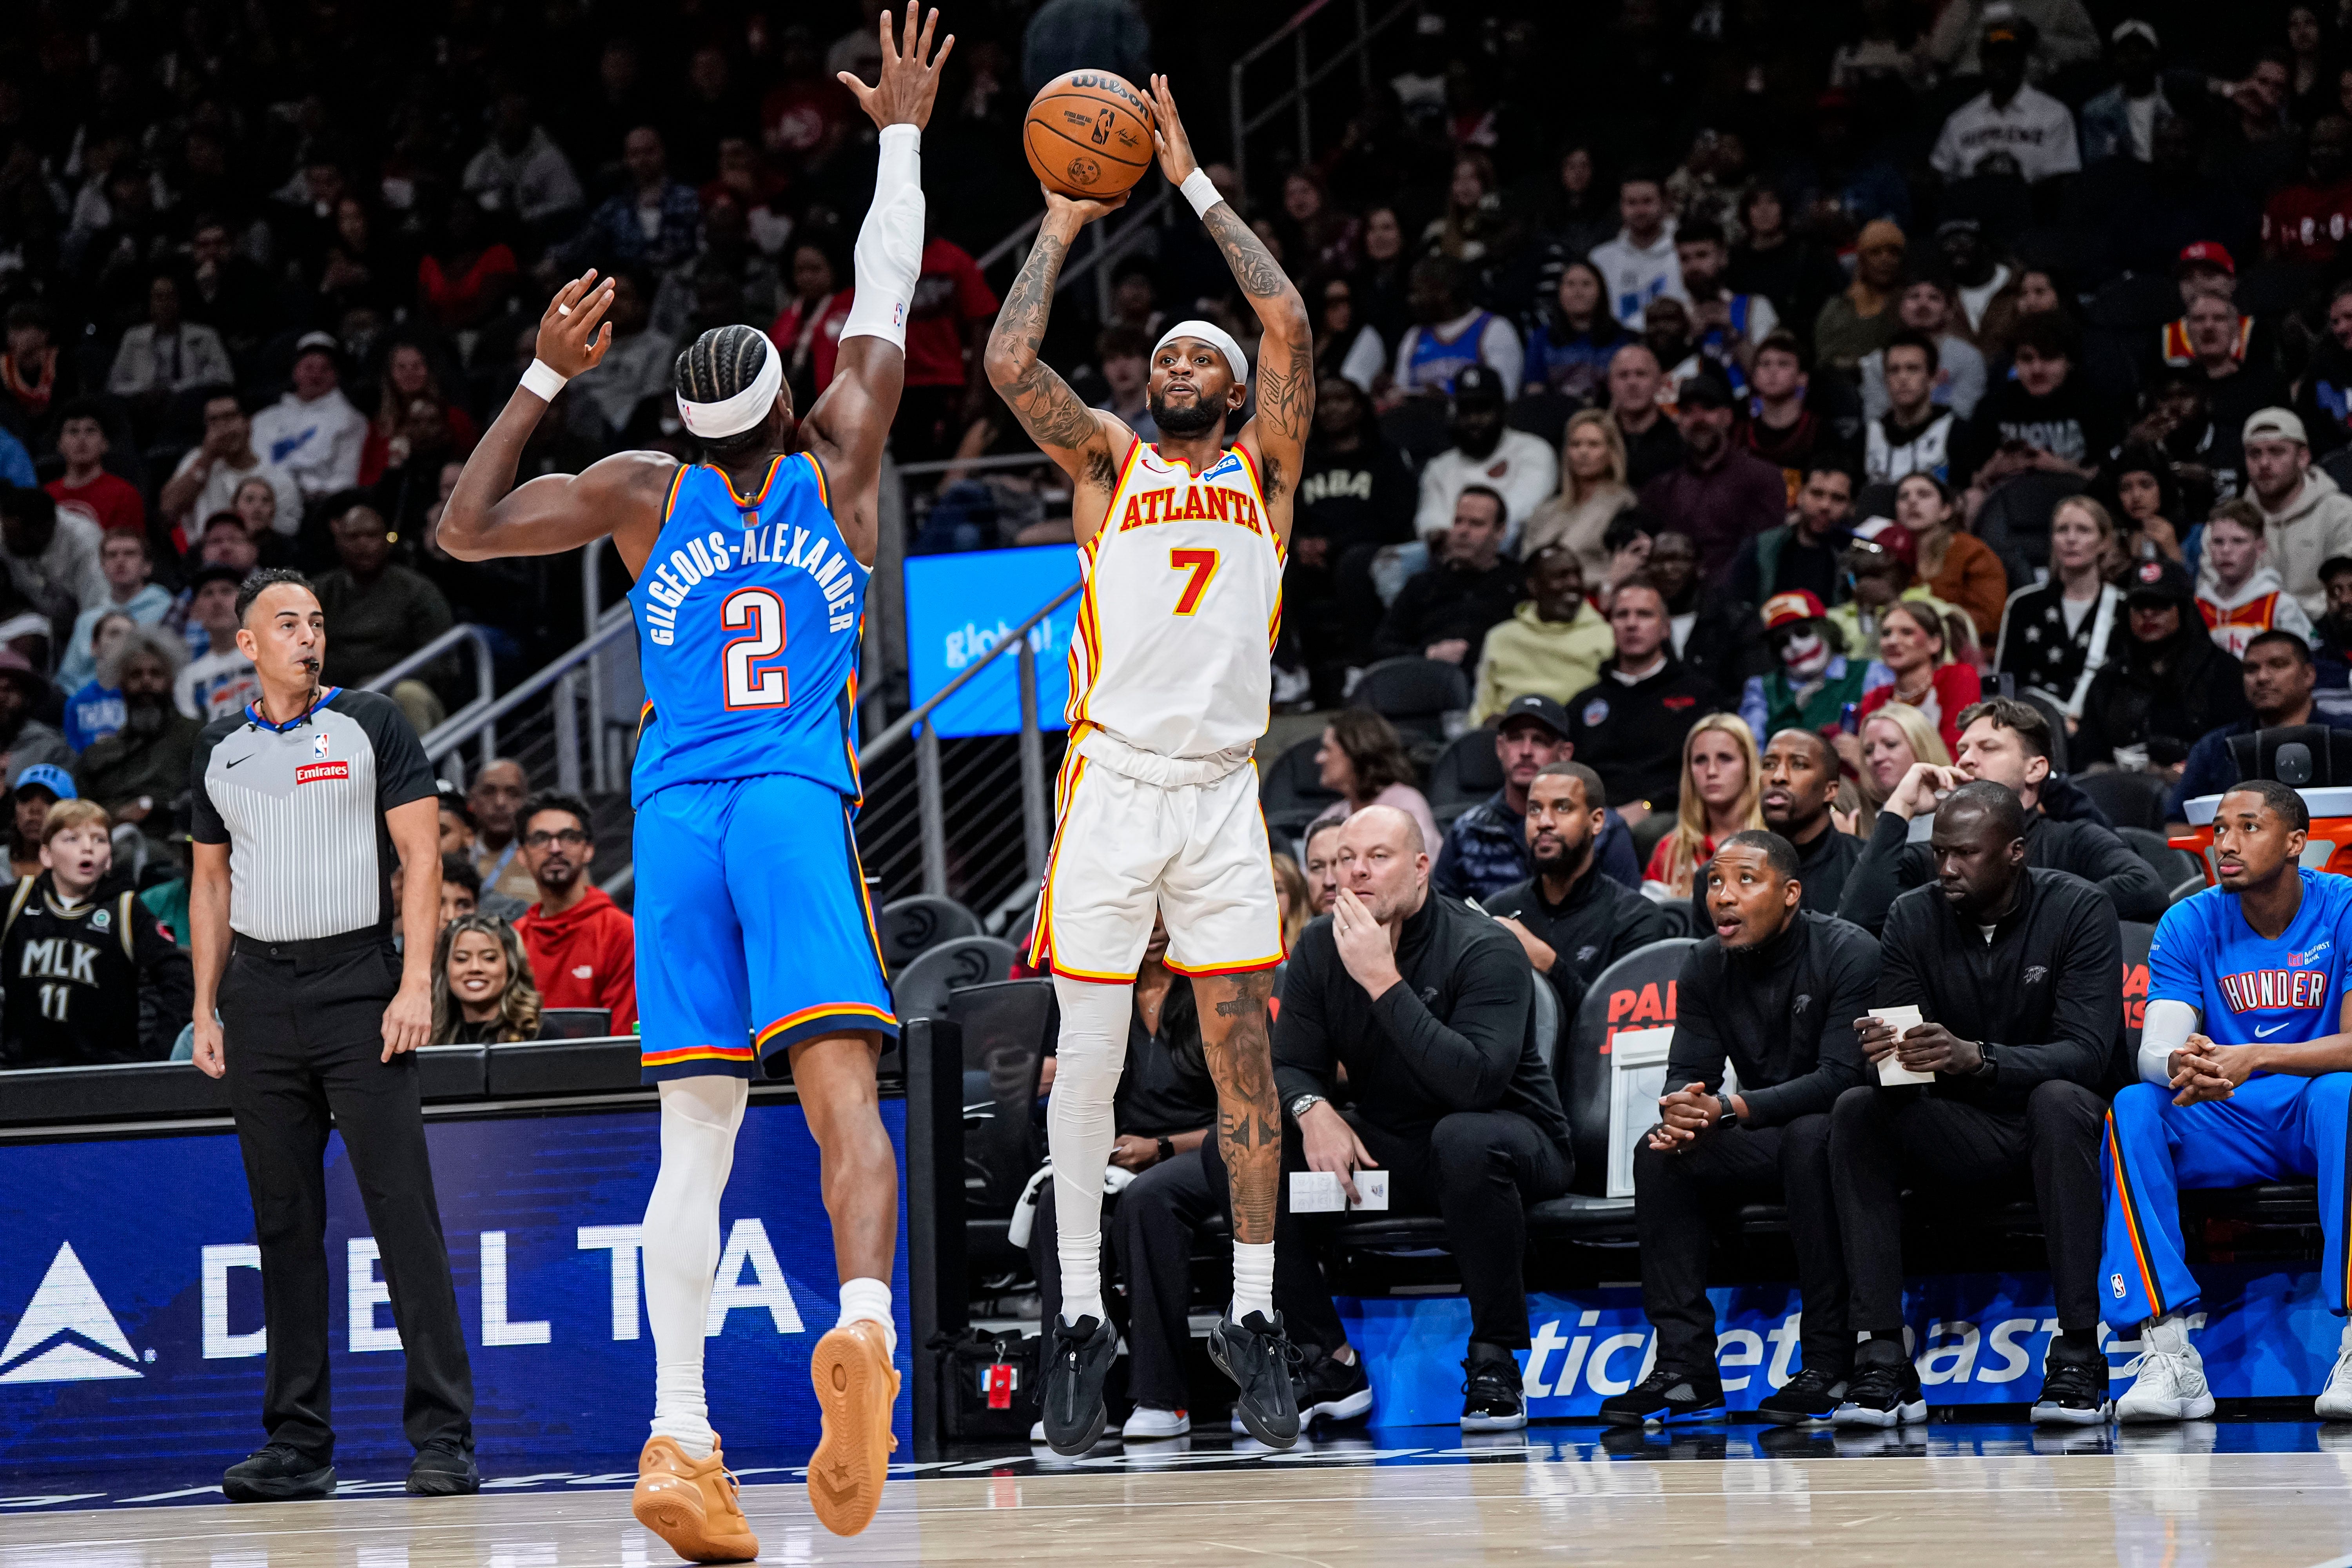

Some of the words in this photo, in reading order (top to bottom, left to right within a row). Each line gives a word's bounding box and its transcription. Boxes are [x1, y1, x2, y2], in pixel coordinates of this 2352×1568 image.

[1071, 75, 1149, 122] Wilson
[1119, 485, 1263, 537] ATLANTA
[1303, 469, 1372, 505] NBA
[646, 523, 854, 646] GILGEOUS-ALEXANDER
[1169, 547, 1220, 616] 7
[720, 587, 789, 711] 2
[297, 765, 347, 781] Emirates
[19, 937, 102, 989] MLK
[38, 983, 71, 1023] 11
[201, 1218, 806, 1360] DELTA
[1072, 1446, 1555, 1466] Gas
